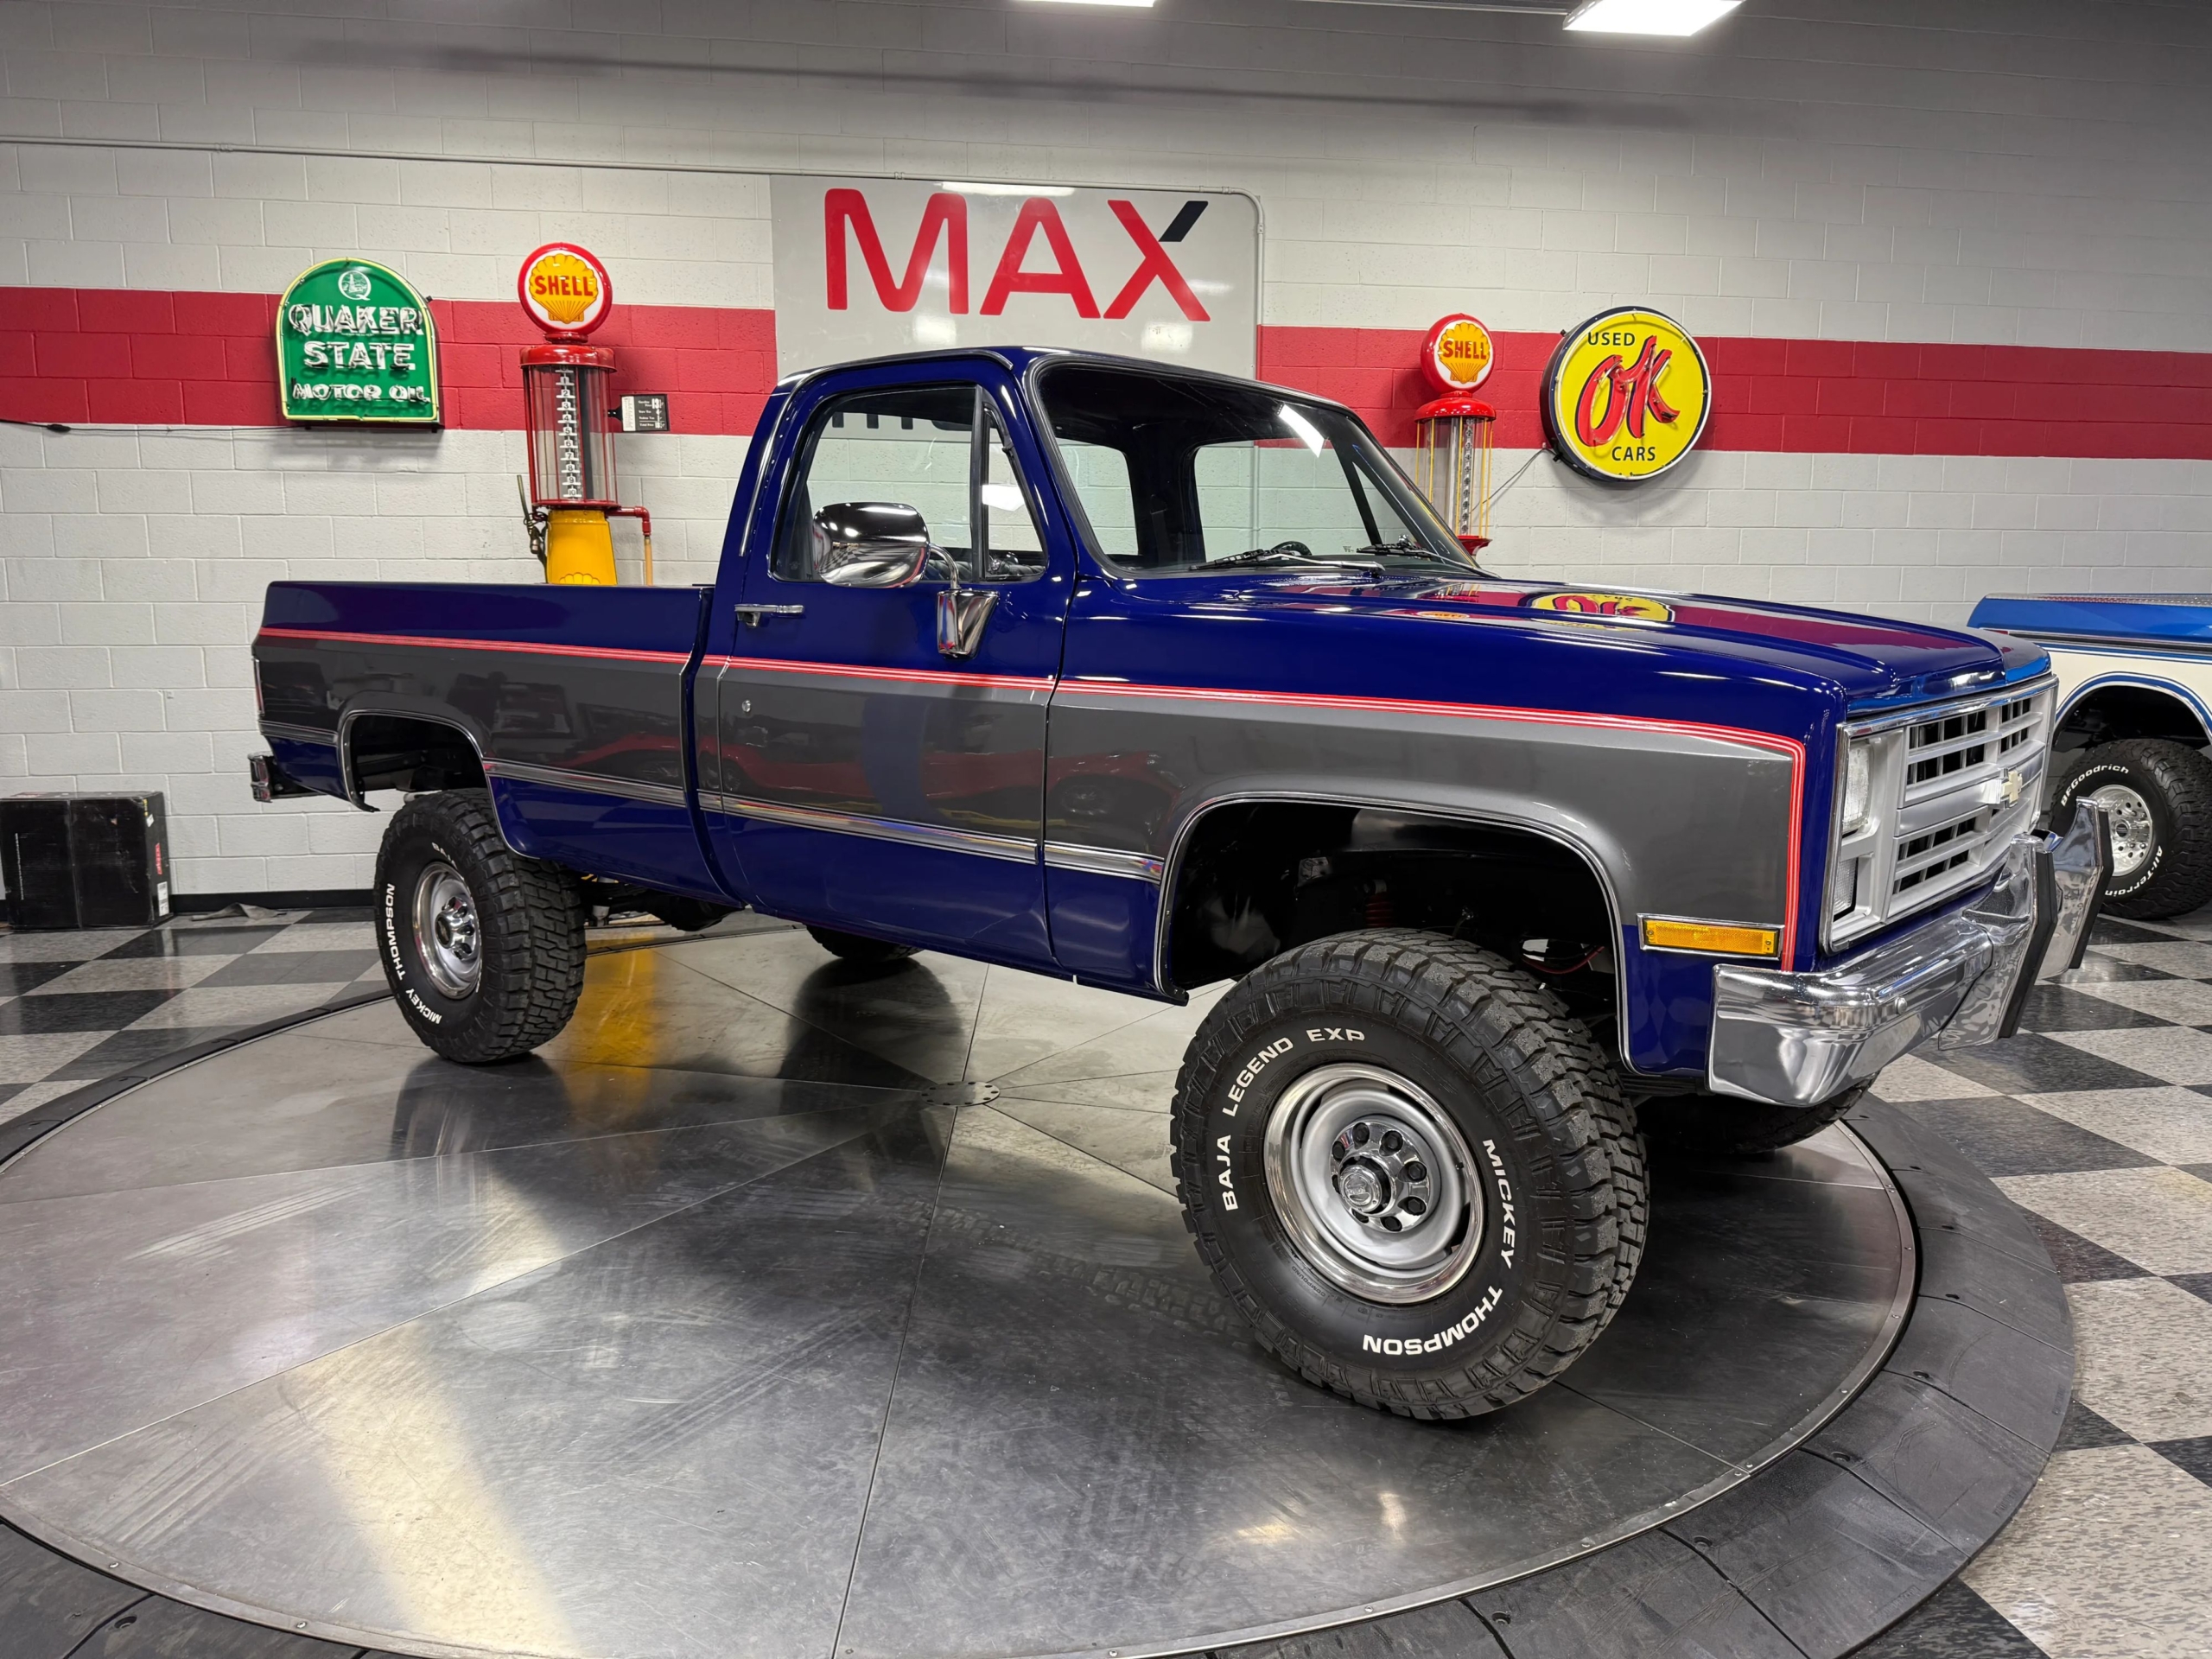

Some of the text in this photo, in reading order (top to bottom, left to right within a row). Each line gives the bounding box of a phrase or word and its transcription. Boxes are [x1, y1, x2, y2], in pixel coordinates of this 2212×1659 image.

[824, 188, 1211, 321] MAX
[534, 275, 594, 296] SHELL
[288, 303, 424, 336] QUAKER
[1443, 340, 1487, 359] SHELL
[1587, 332, 1636, 346] USED
[303, 341, 416, 371] STATE
[292, 383, 431, 403] MOTOR OIL
[1574, 335, 1681, 447] OK
[1611, 446, 1656, 461] CARS
[2060, 764, 2129, 807] BFGoodrich
[385, 883, 442, 1025] MICKEY THOMPSON
[1306, 1027, 1365, 1042] EXP
[1222, 1037, 1294, 1117] LEGEND
[1217, 1135, 1238, 1211] BAJA
[1363, 1139, 1516, 1355] MICKEY THOMPSON
[1291, 1266, 1326, 1297] COMPOUND
